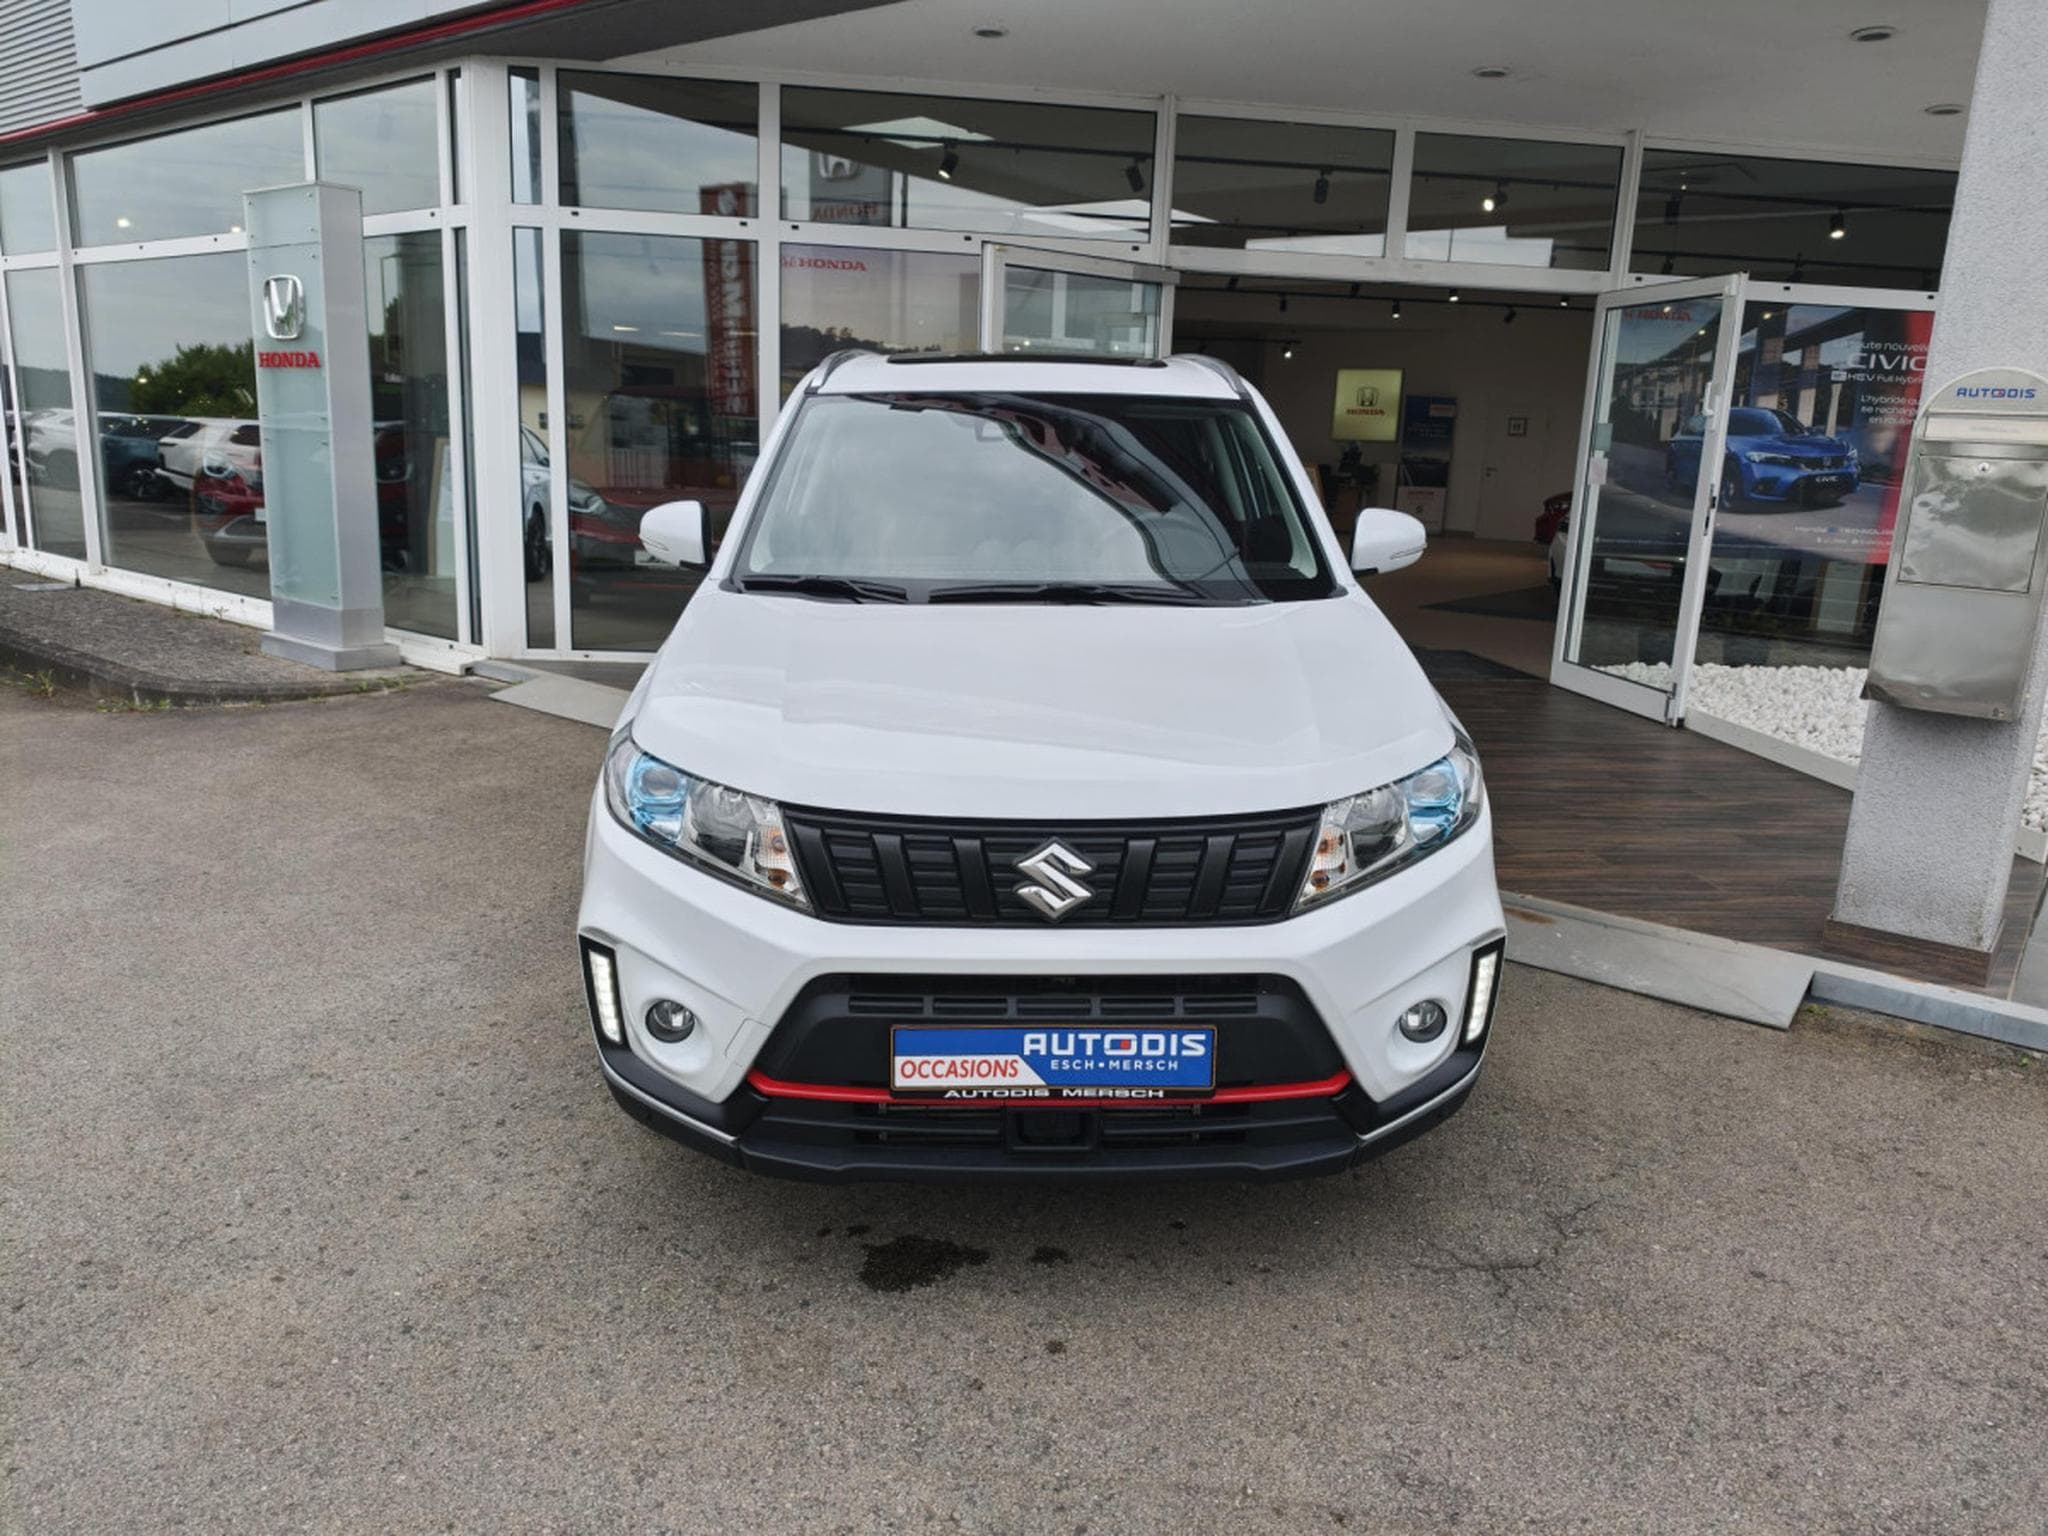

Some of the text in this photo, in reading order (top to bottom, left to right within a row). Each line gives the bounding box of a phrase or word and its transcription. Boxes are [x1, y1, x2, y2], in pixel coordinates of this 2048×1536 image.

[800, 257, 868, 271] HONDA
[258, 352, 321, 368] HONDA
[1848, 353, 1927, 371] CIVIC
[1956, 387, 2037, 399] AUTODIS
[1023, 1033, 1207, 1057] AUTODIS
[900, 1058, 1019, 1079] OCCASIONS
[944, 1088, 1164, 1099] AUTODIS MERSCH
